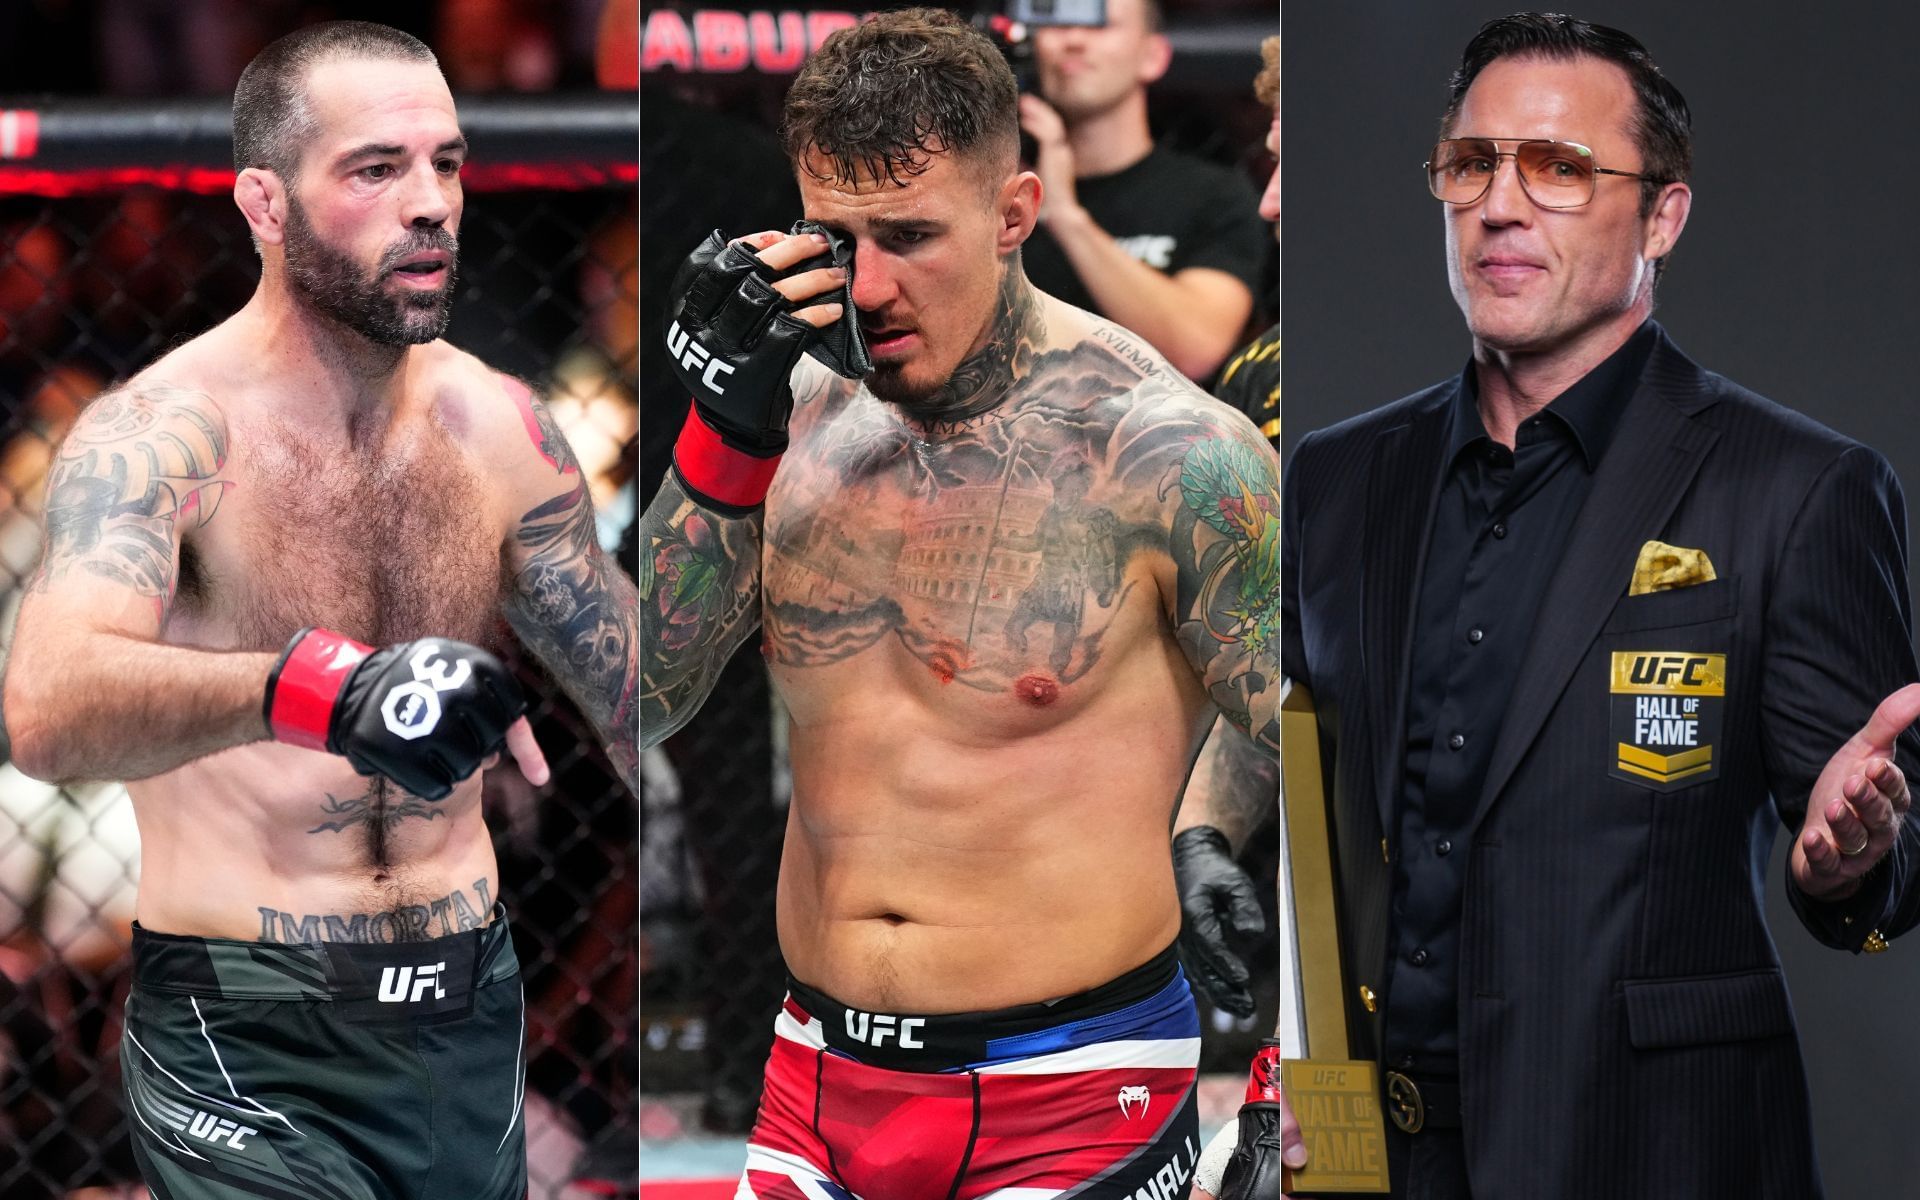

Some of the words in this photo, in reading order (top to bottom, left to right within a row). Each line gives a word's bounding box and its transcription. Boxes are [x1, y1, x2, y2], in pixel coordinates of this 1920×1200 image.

[667, 319, 736, 396] UFC
[1629, 656, 1709, 687] UFC
[1635, 696, 1682, 719] HALL
[1682, 698, 1700, 713] OF
[1634, 719, 1699, 746] FAME
[257, 877, 494, 944] IMMORTAL
[378, 961, 446, 1003] UFC
[844, 1008, 926, 1049] UFC
[1312, 1069, 1347, 1087] UFC
[1352, 1096, 1375, 1119] OF
[188, 1110, 259, 1151] UFC
